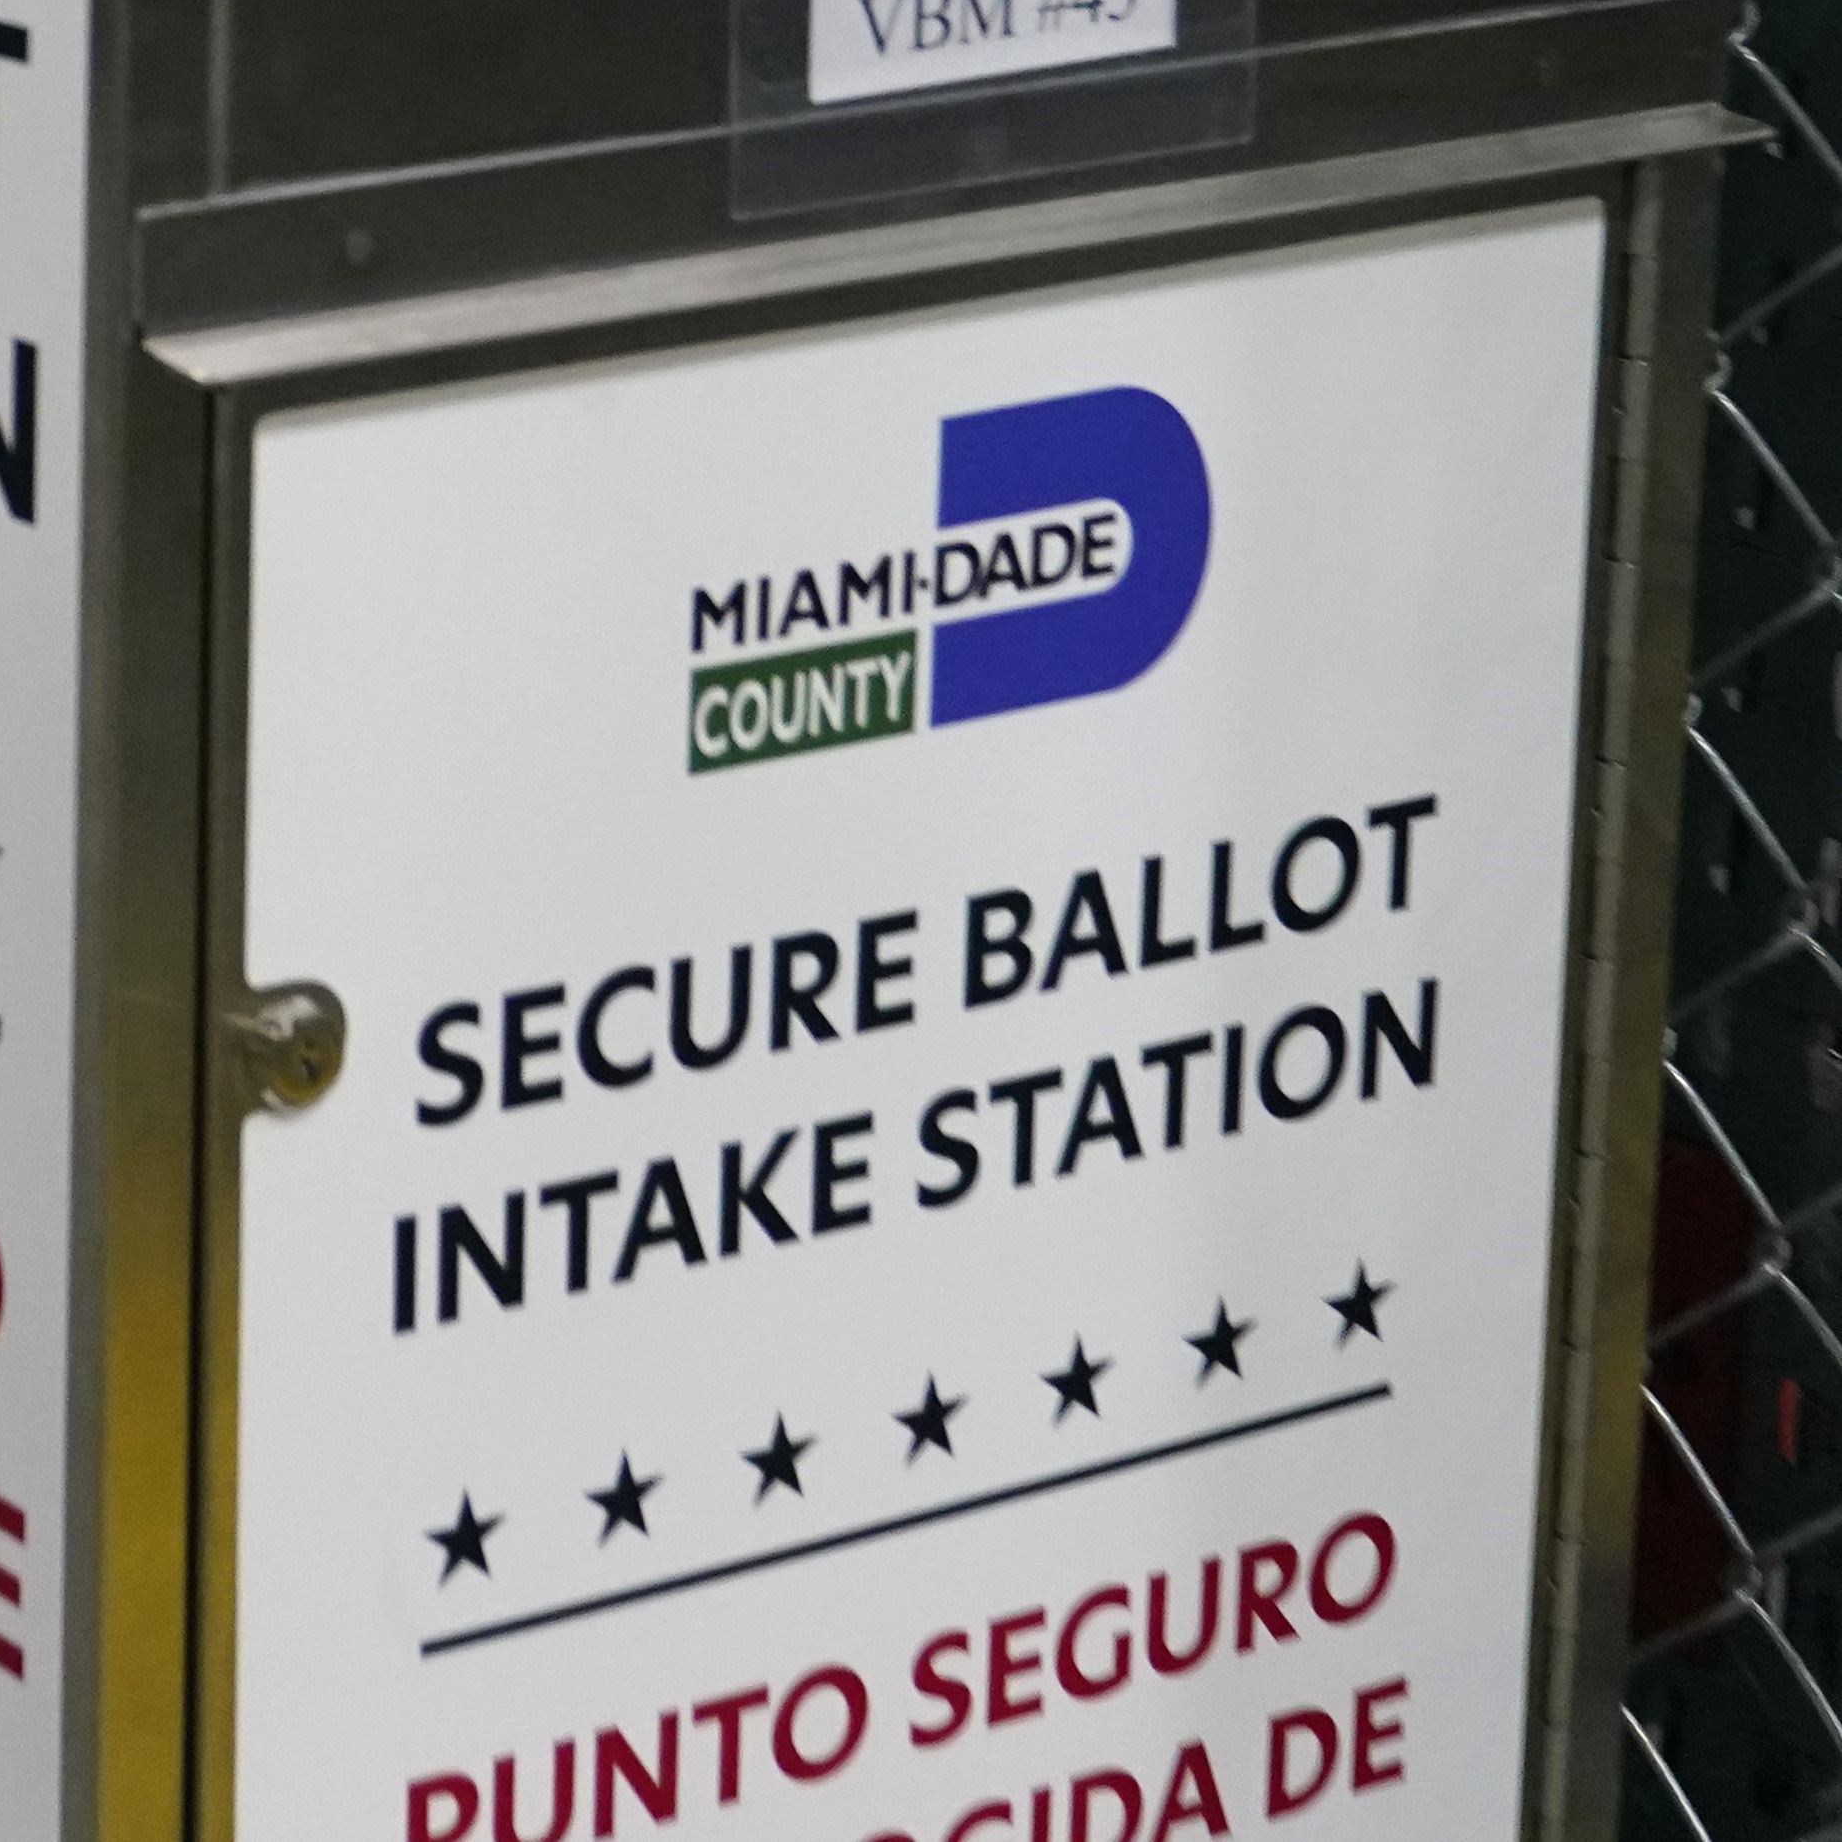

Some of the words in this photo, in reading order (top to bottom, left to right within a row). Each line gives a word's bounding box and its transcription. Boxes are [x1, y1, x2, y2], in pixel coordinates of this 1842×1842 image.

[691, 511, 1116, 651] MIAMI-DADE
[693, 653, 913, 755] COUNTY
[417, 910, 918, 1127] SECURE
[965, 795, 1437, 1010] BALLOT
[393, 1113, 874, 1334] INTAKE
[918, 978, 1440, 1206] STATION
[403, 1663, 869, 1842] PUNTO
[909, 1511, 1396, 1746] SEGURO
[1266, 1678, 1408, 1821] DE
